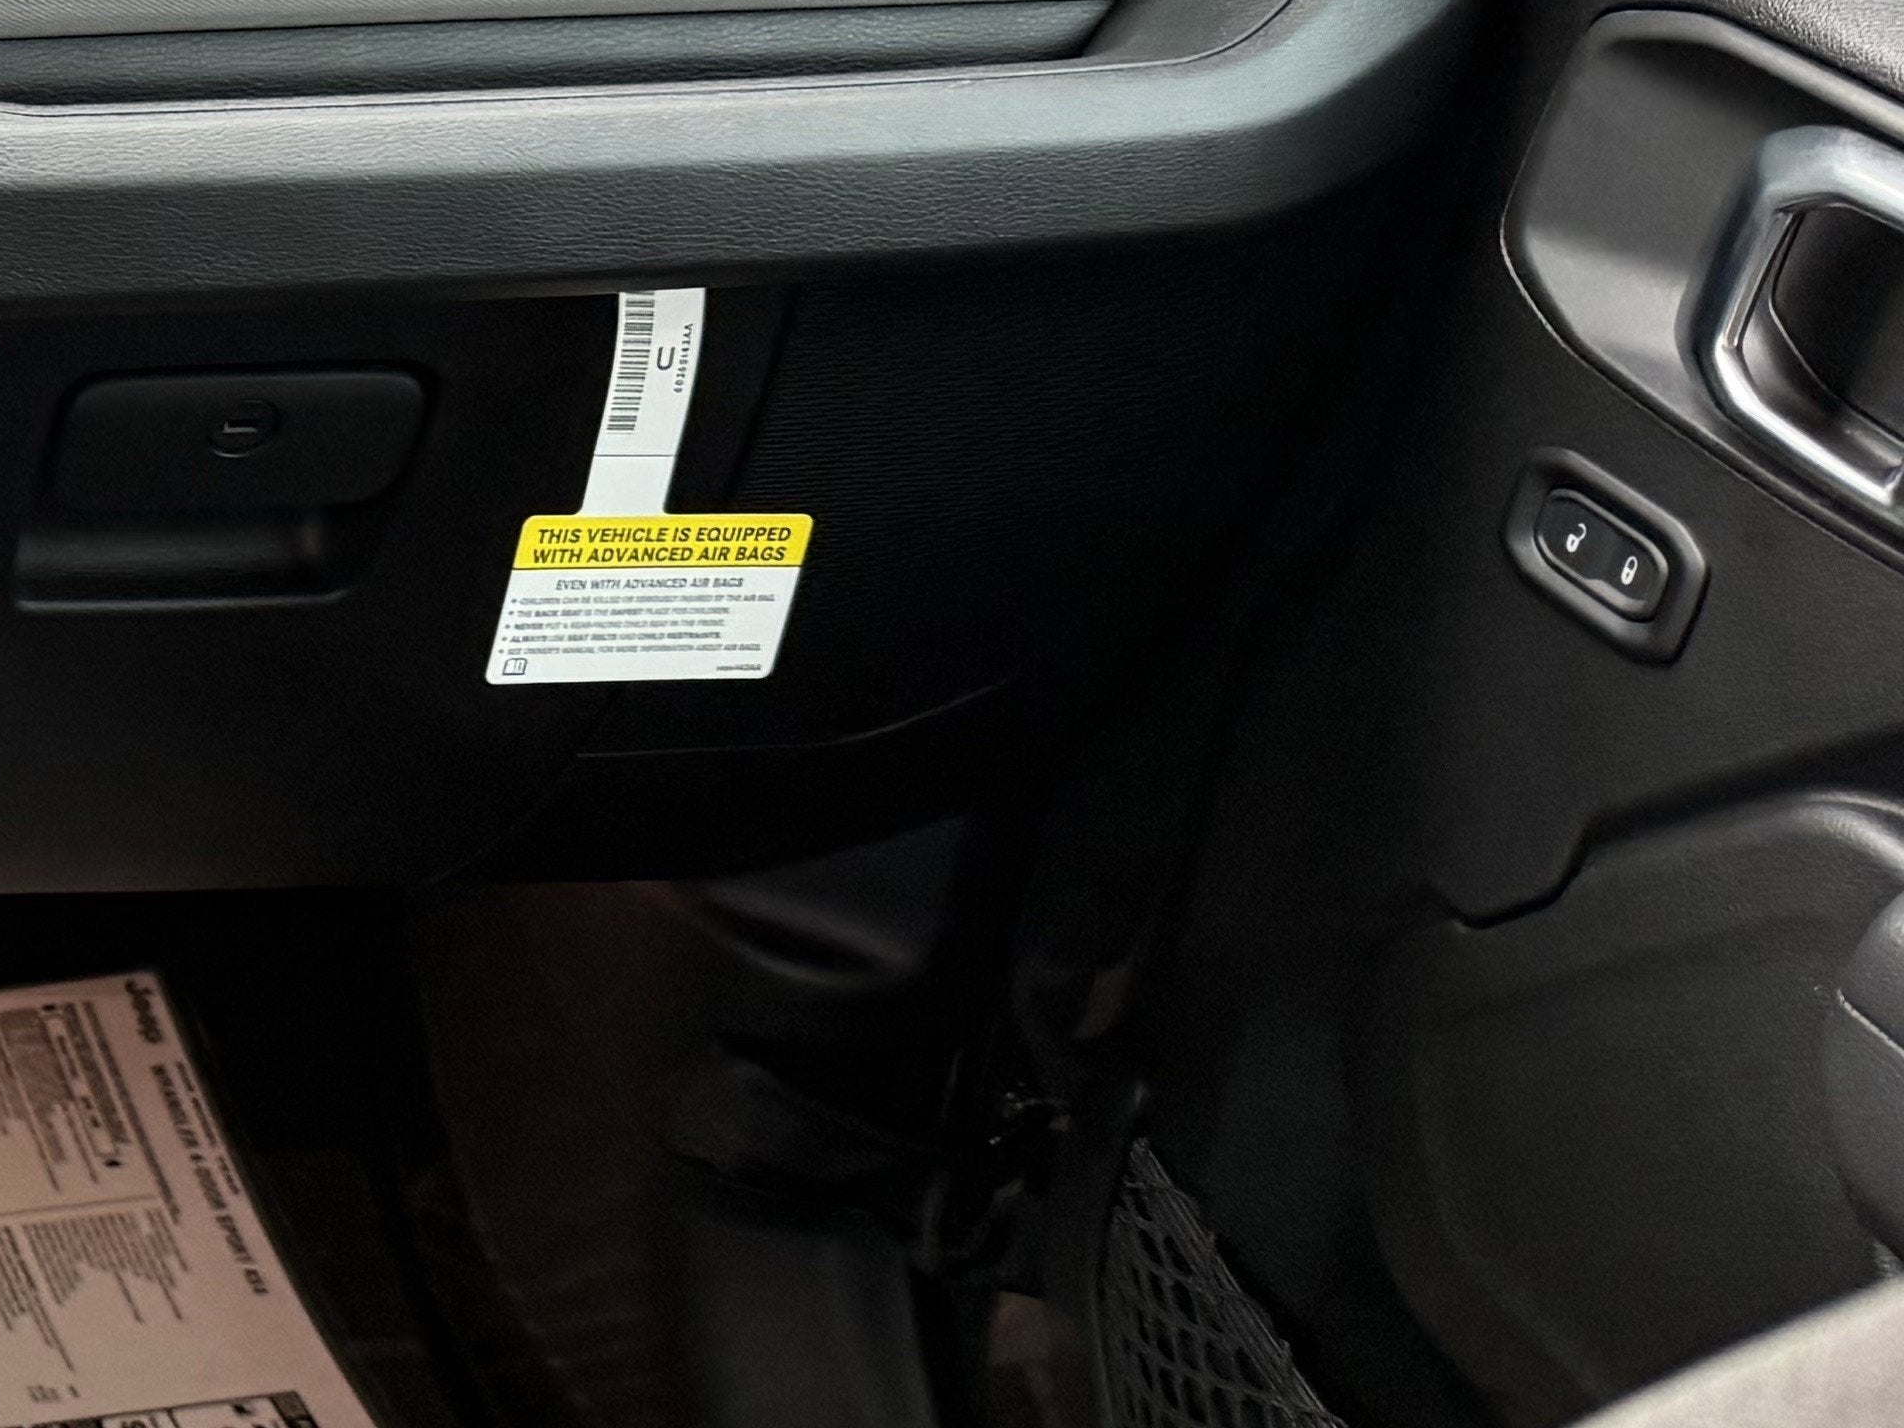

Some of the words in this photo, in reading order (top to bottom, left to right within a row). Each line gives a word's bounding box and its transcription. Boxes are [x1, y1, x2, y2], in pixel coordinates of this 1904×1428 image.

[538, 528, 580, 545] THIS
[588, 527, 667, 543] VEHICLE
[672, 527, 692, 542] IS
[695, 526, 792, 542] EQUIPPED
[533, 548, 582, 564] WITH
[586, 547, 694, 563] ADVANCED
[697, 547, 729, 562] AIR
[734, 546, 787, 562] BAGS
[590, 578, 621, 590] WITH
